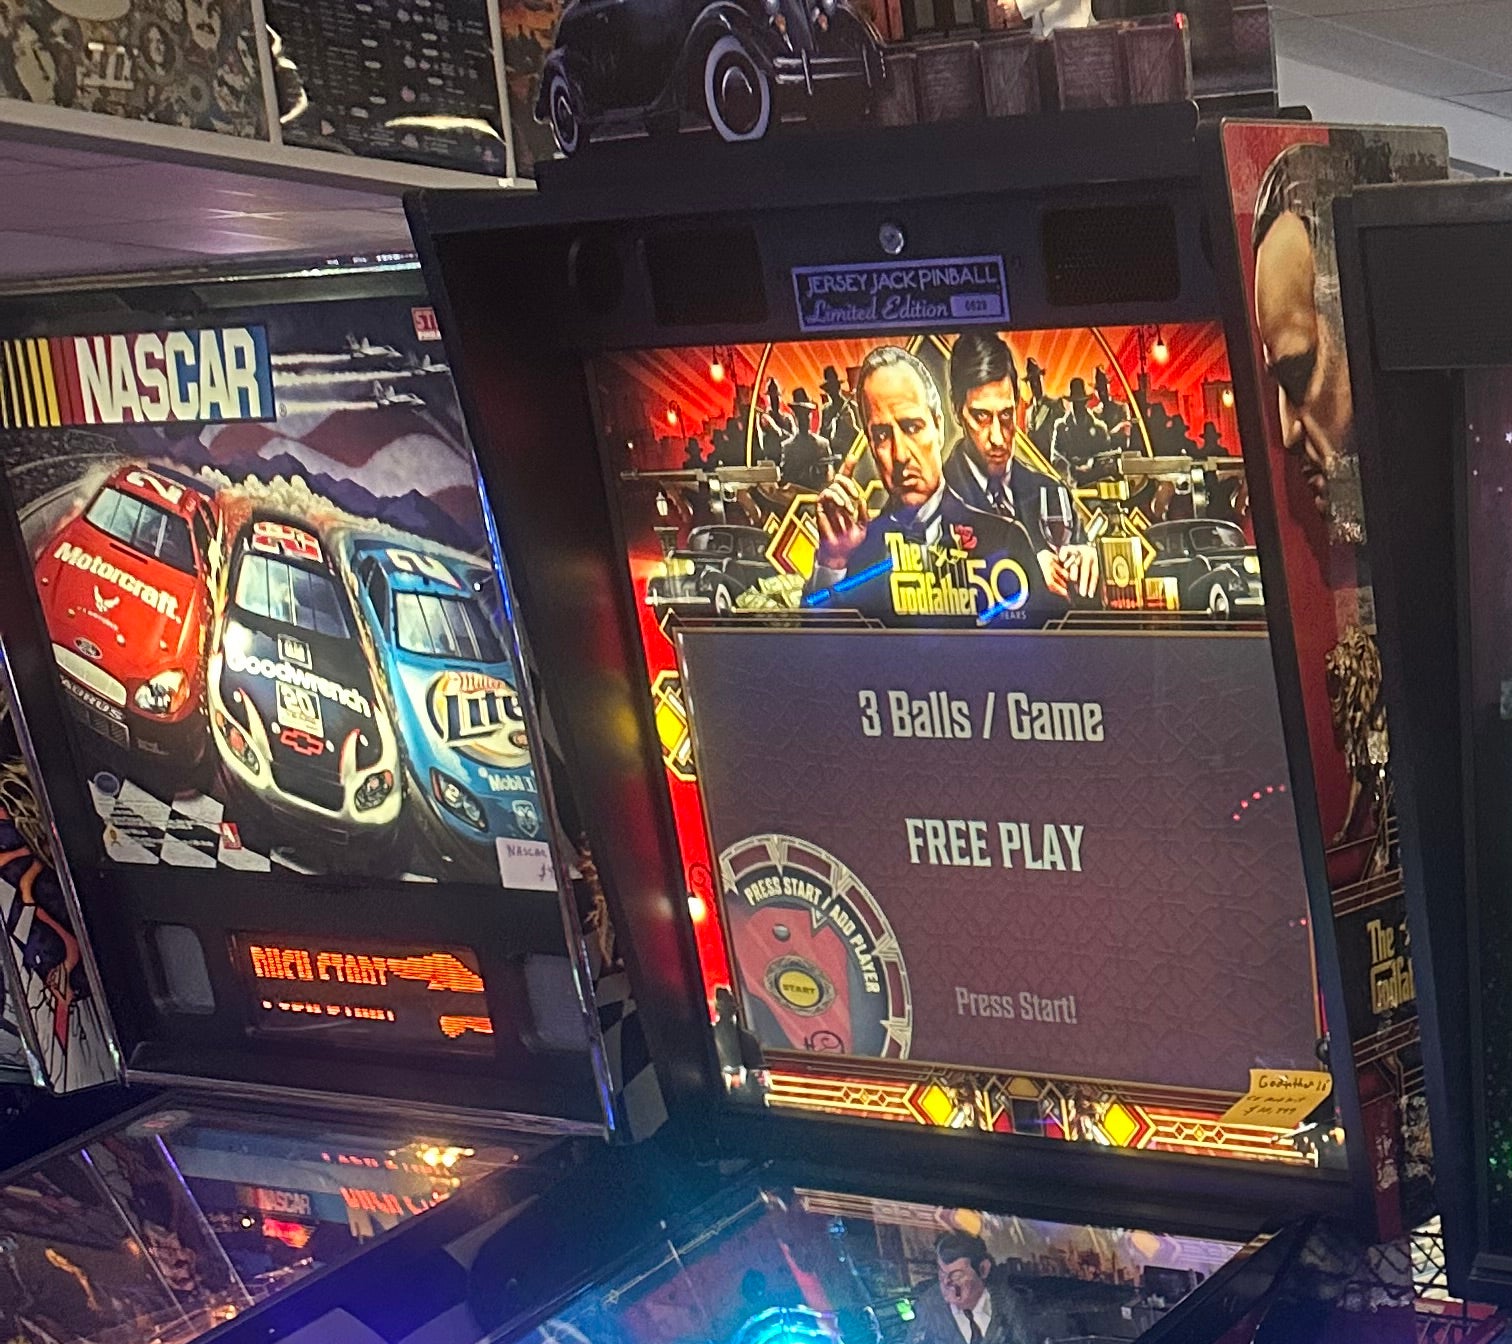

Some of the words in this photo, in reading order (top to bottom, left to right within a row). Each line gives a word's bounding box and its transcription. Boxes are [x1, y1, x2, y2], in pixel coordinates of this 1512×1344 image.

[807, 273, 870, 297] JERSEY
[870, 270, 917, 295] JACK
[917, 267, 998, 291] PINBALL
[807, 298, 879, 324] Limited
[882, 296, 950, 320] Edition
[75, 327, 262, 424] NASCAR
[884, 532, 923, 572] The
[889, 571, 979, 616] Godfather
[966, 558, 1030, 626] 50
[225, 652, 373, 719] Goodwrench
[859, 690, 883, 738] 3
[891, 690, 974, 740] Balls
[982, 692, 997, 739] /
[1007, 692, 1106, 743] Game
[905, 817, 992, 867] FREE
[998, 822, 1086, 872] PLAY
[743, 876, 783, 907] PRESS
[782, 877, 823, 905] START
[829, 903, 857, 937] ADD
[849, 933, 881, 994] PLAYER
[1366, 918, 1395, 964] The
[782, 983, 817, 996] START
[954, 987, 1015, 1022] Press
[1020, 990, 1079, 1026] Start!
